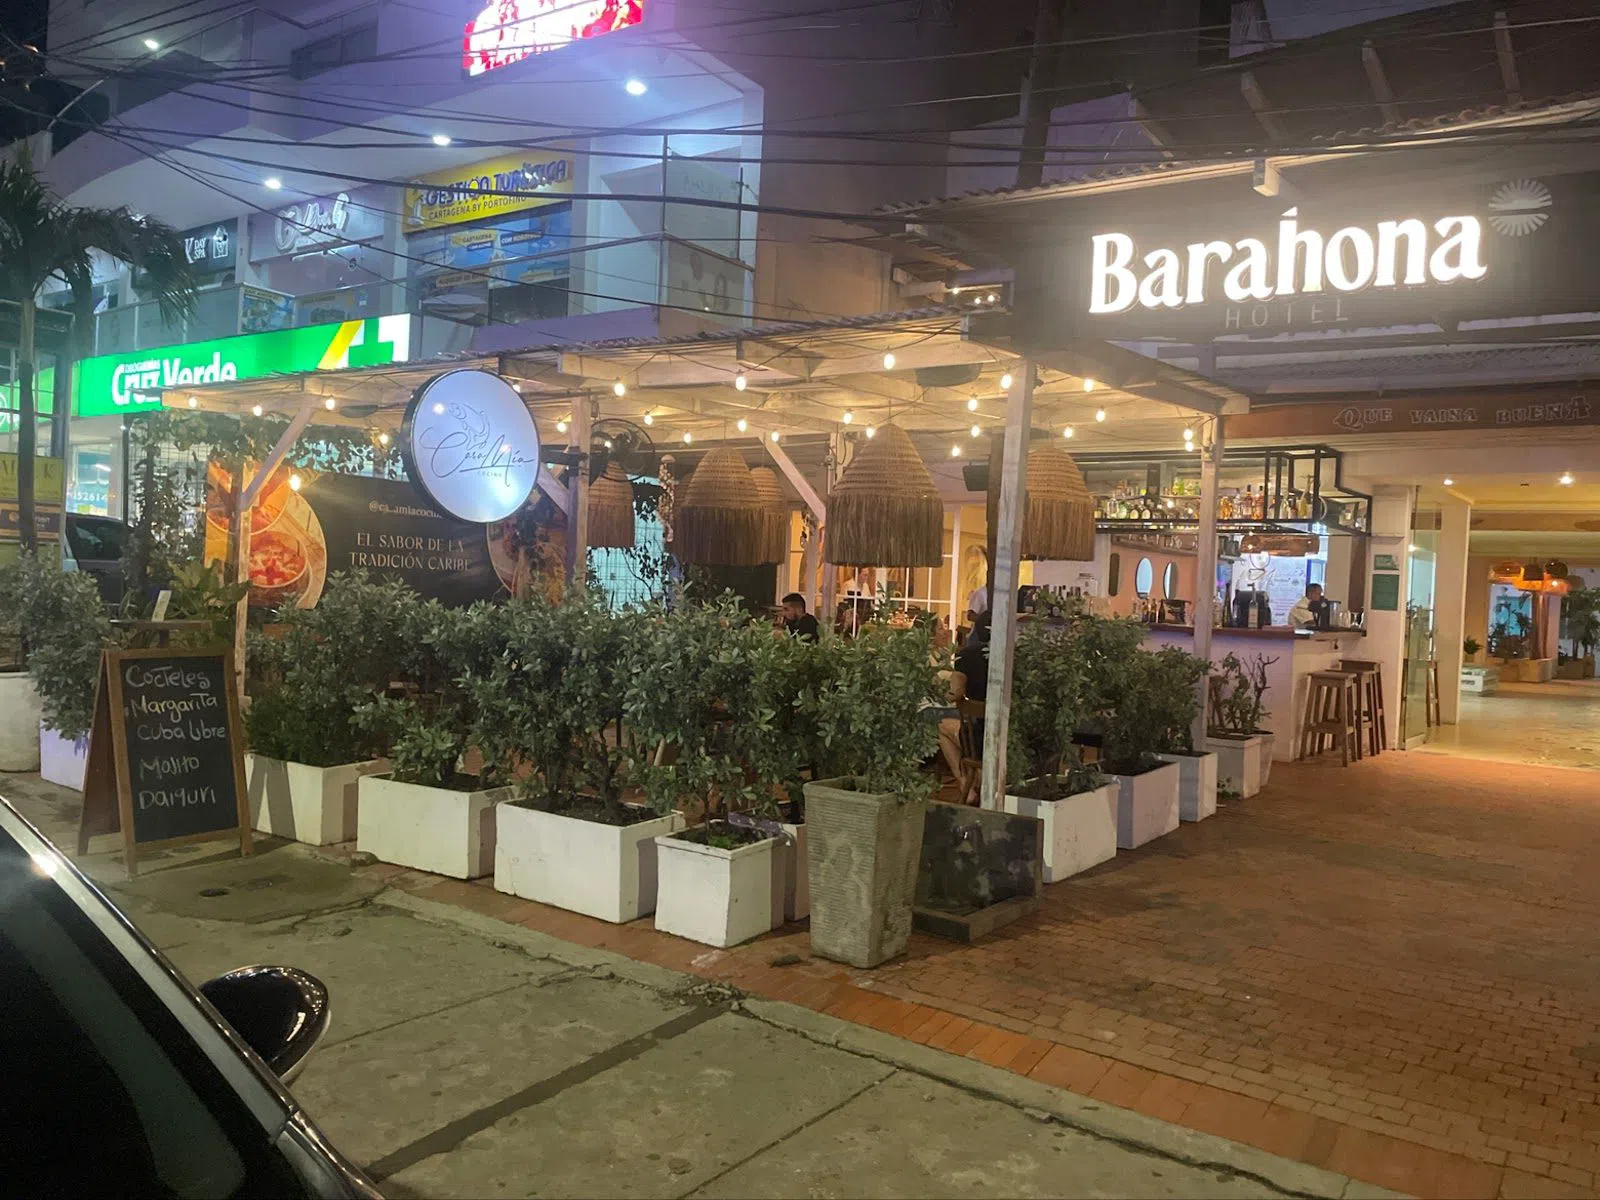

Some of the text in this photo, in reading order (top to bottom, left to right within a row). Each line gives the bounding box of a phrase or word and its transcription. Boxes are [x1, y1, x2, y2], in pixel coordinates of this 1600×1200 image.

[429, 207, 470, 221] CARTAGENA
[472, 204, 482, 213] BY
[1088, 206, 1488, 314] Barahona
[1226, 300, 1348, 329] HOTEL
[162, 352, 237, 386] Verde
[1409, 408, 1478, 424] VAINA
[1496, 396, 1591, 424] BUENA
[357, 532, 373, 546] EL
[379, 534, 424, 550] SABOR
[349, 551, 423, 569] TRADICIÓN
[137, 723, 186, 741] Cuba
